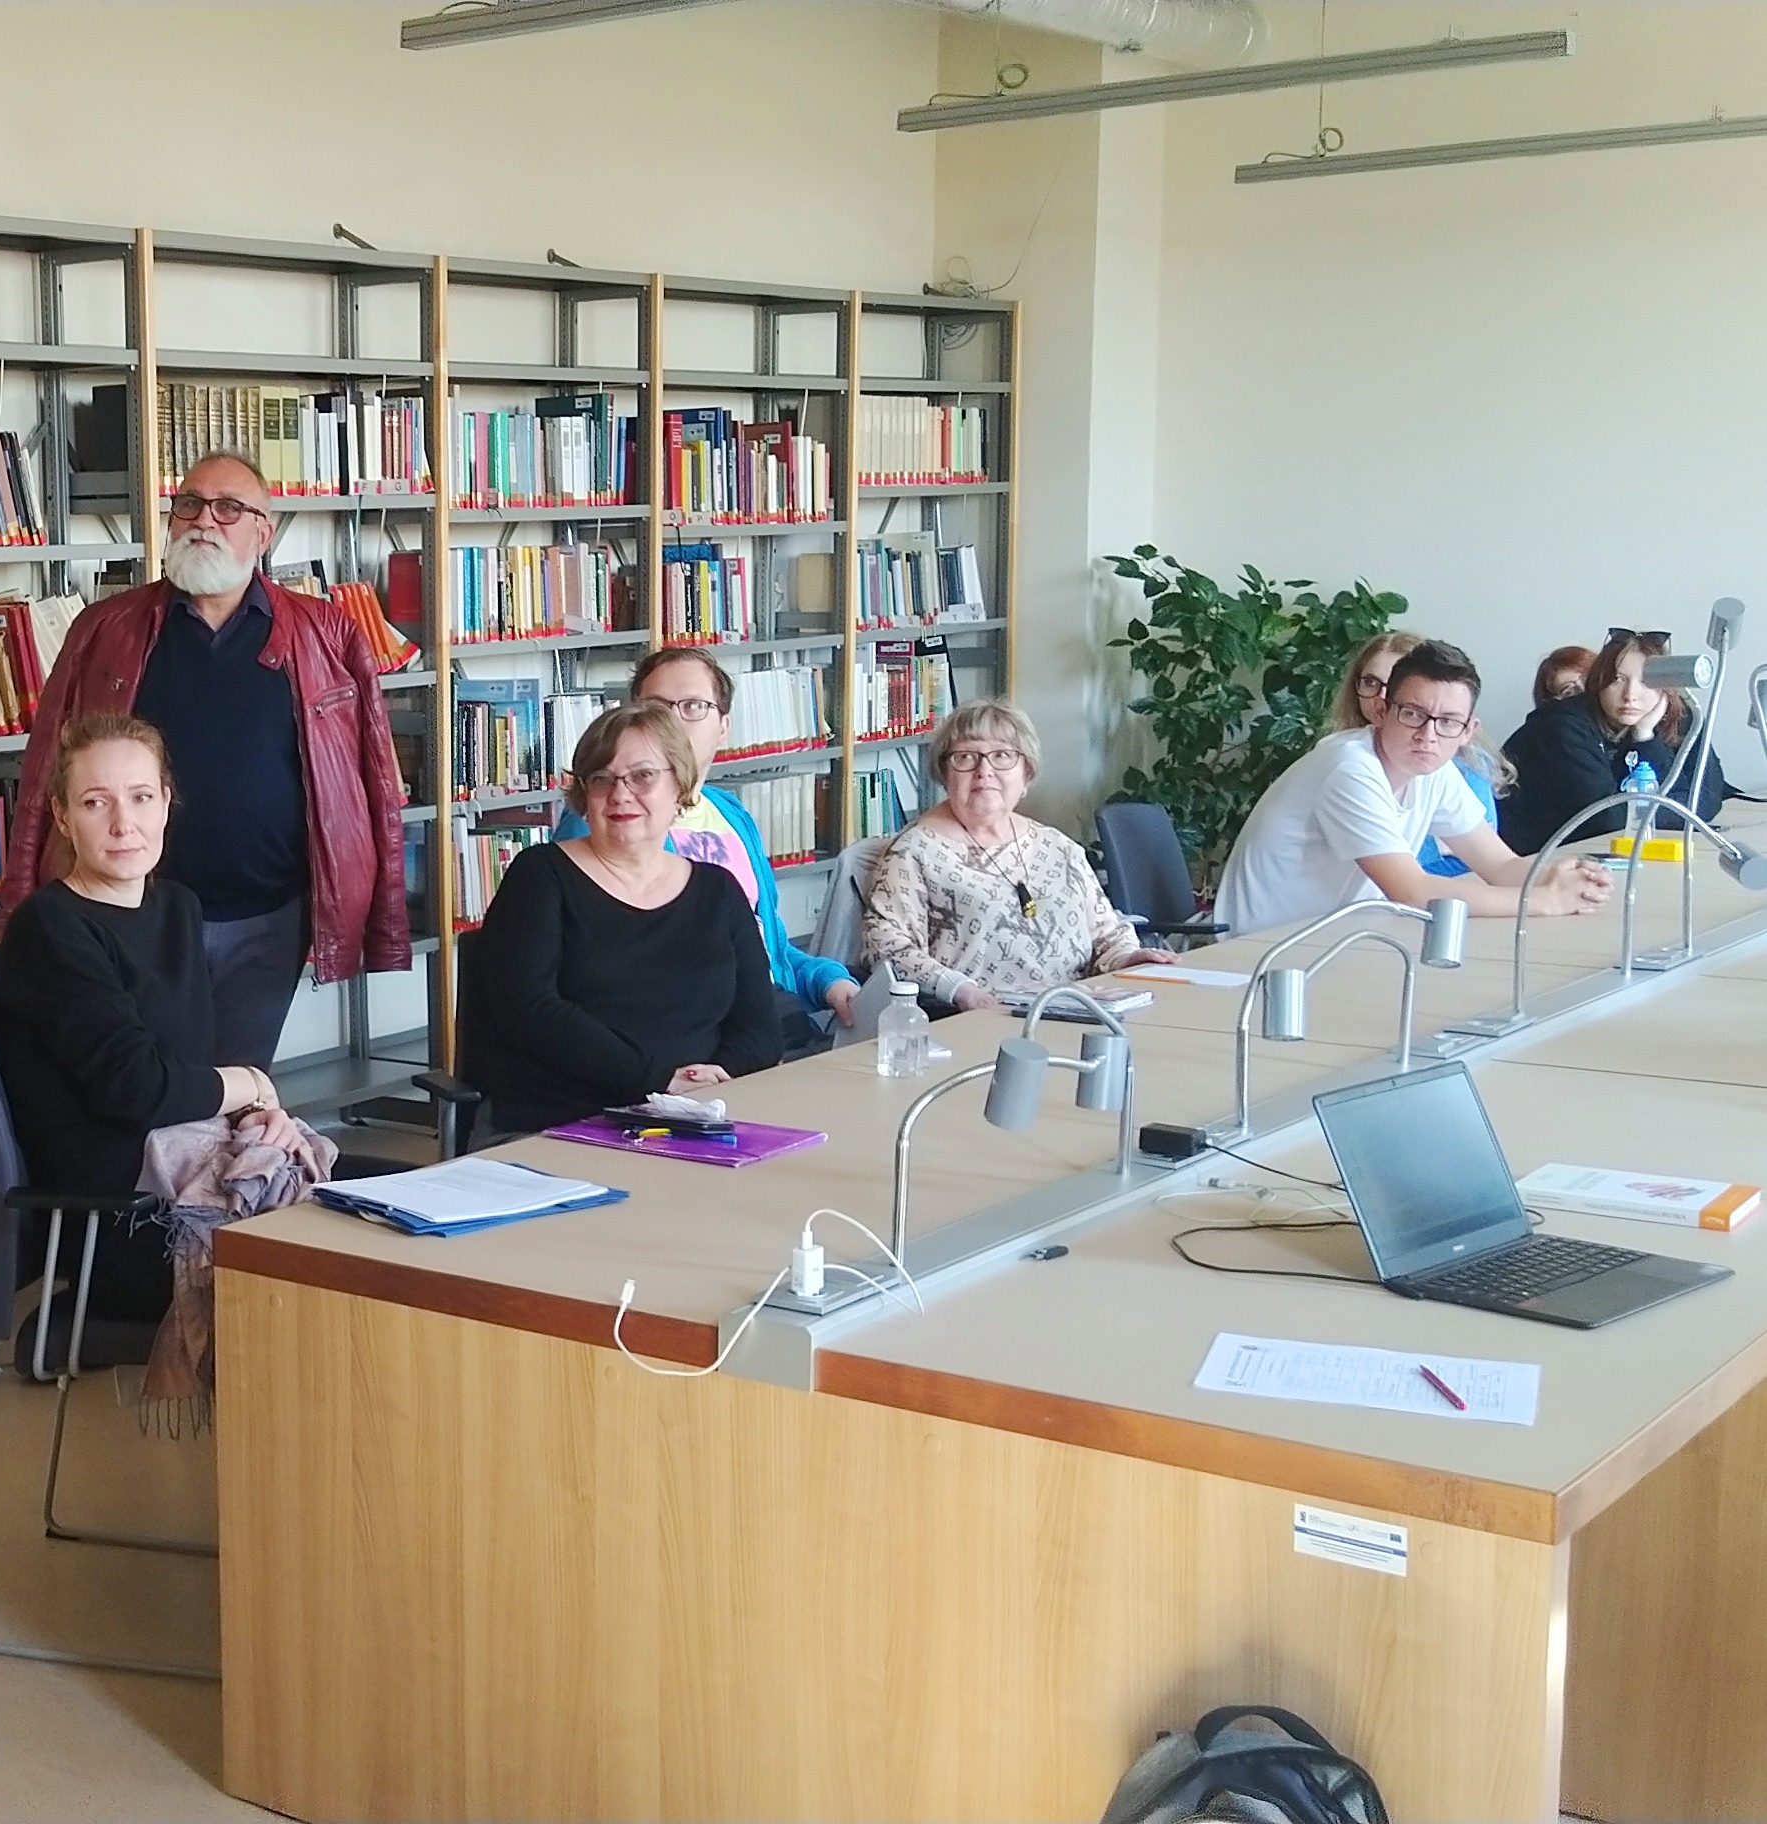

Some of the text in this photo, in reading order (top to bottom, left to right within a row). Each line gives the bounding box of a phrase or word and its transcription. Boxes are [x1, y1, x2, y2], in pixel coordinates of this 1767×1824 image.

[395, 482, 402, 491] G
[669, 512, 676, 521] O
[725, 633, 732, 642] R
